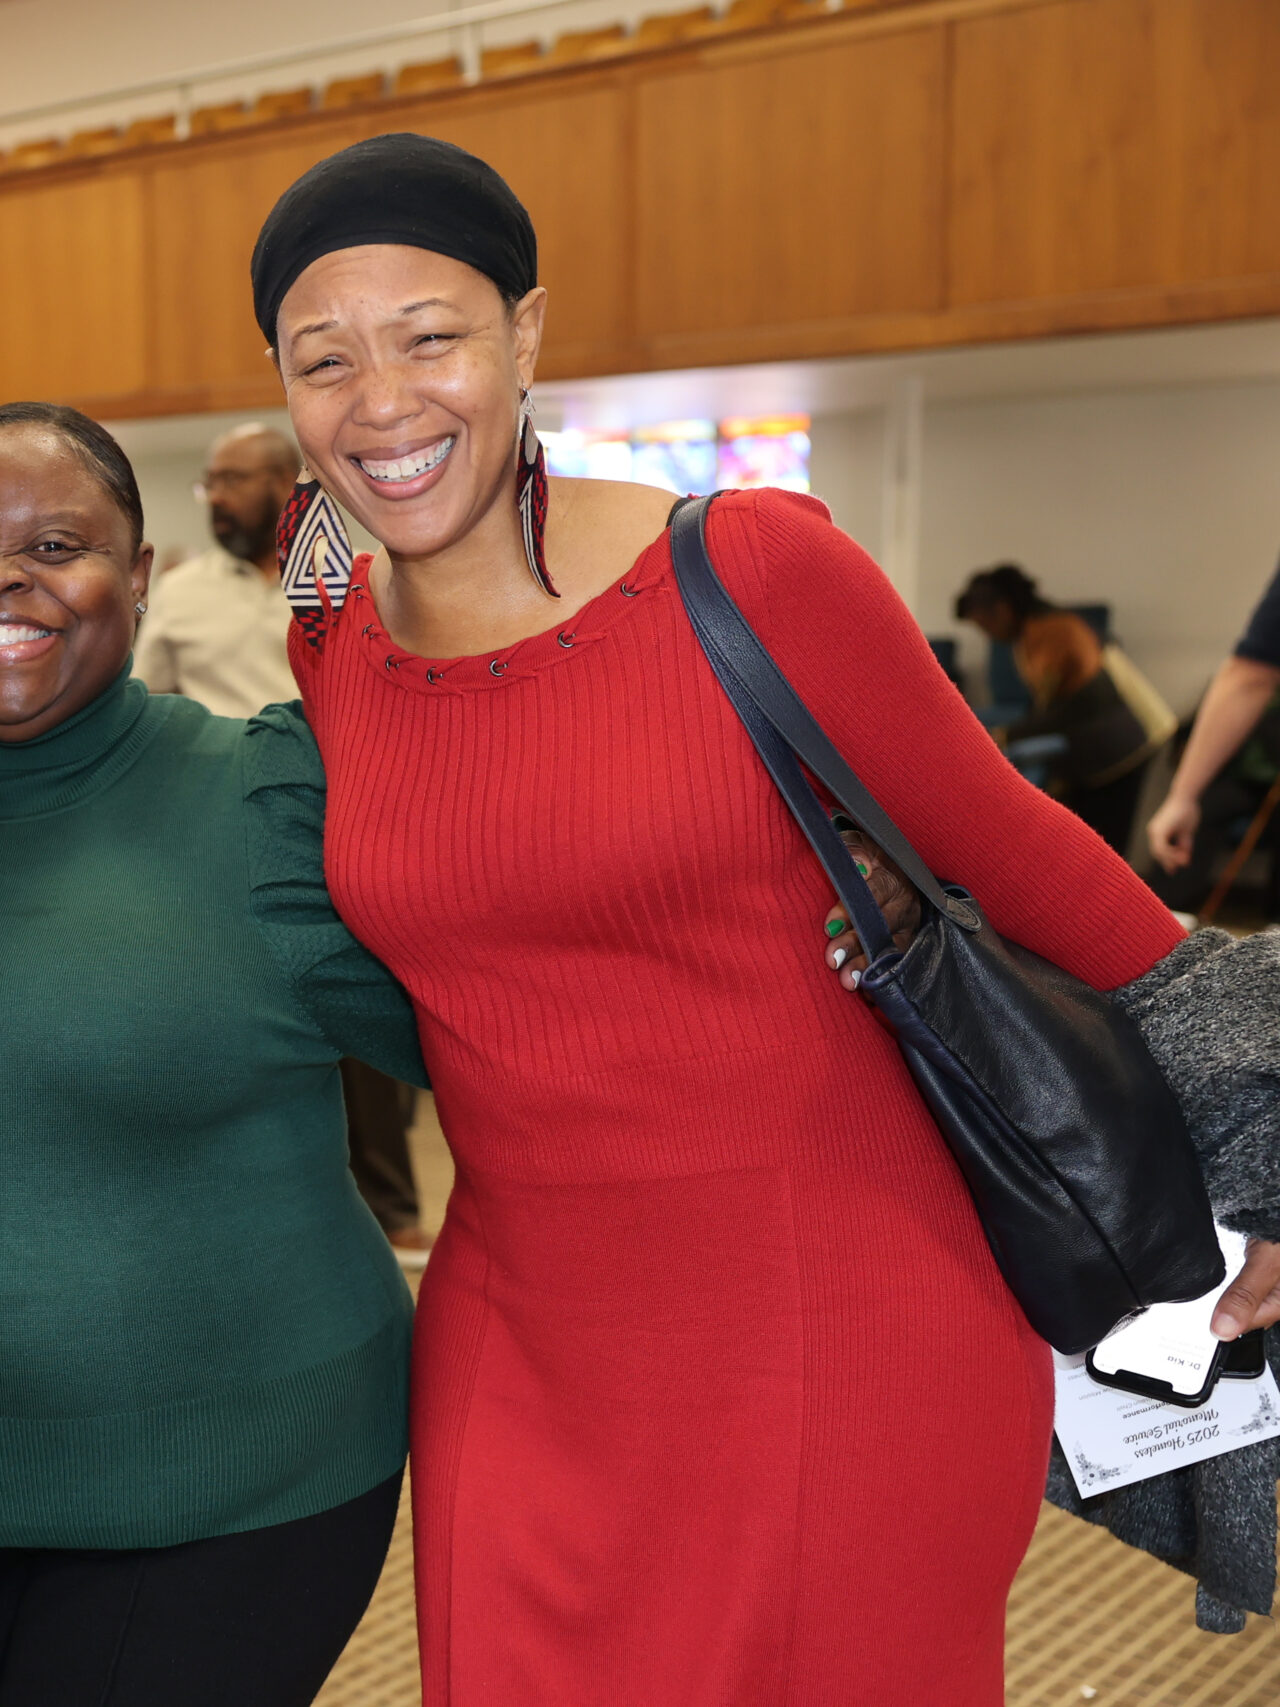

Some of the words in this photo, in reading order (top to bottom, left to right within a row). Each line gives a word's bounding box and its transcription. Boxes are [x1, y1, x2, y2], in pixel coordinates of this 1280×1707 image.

[1186, 1360, 1201, 1371] Dr.
[1163, 1408, 1219, 1435] Memorial
[1122, 1426, 1163, 1446] Service
[1186, 1424, 1220, 1446] 2025
[1133, 1435, 1186, 1460] Homeless
